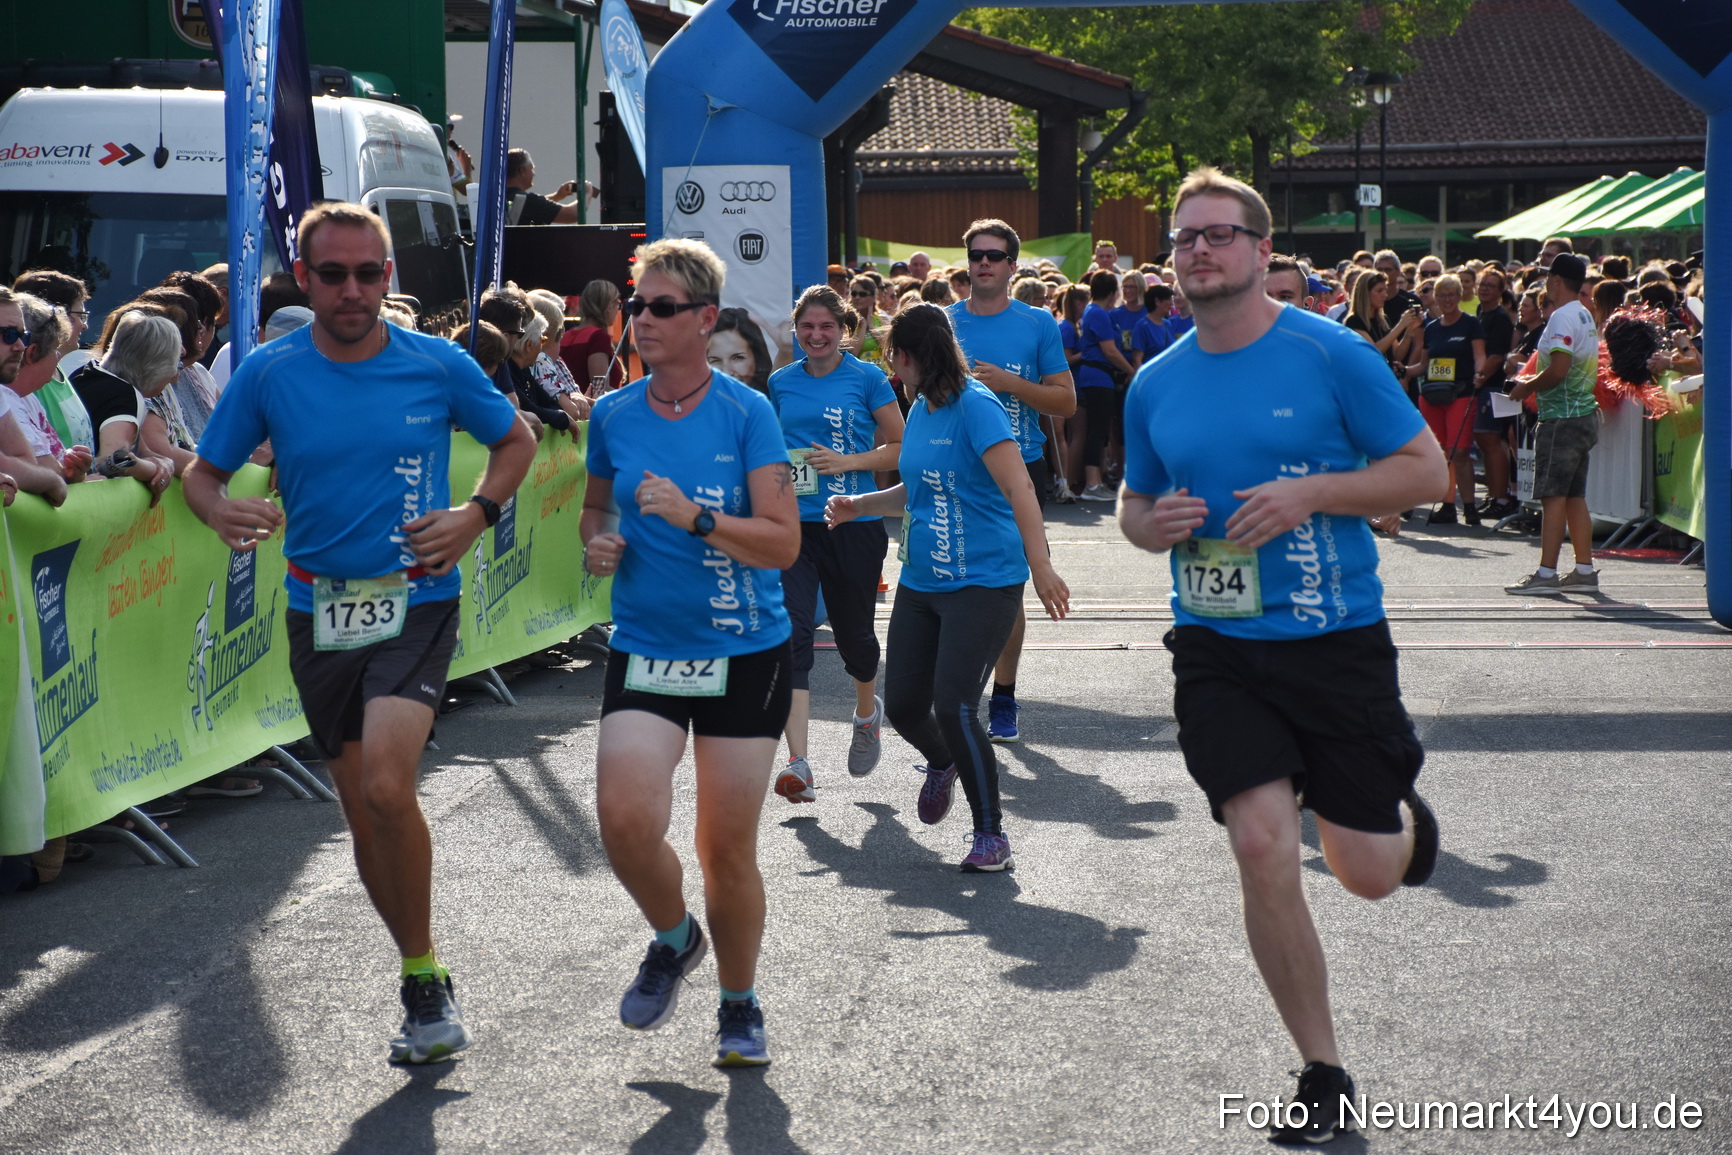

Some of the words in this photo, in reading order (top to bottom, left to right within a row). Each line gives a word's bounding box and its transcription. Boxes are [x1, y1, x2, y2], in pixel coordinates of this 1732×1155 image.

[775, 0, 888, 15] Fischer
[784, 17, 878, 28] AUTOMOBILE
[1362, 187, 1377, 203] WC
[722, 207, 746, 215] Audi
[742, 239, 762, 255] FIAT
[1430, 366, 1451, 375] 1386
[405, 414, 431, 425] Benni
[1273, 408, 1293, 417] Willi
[714, 453, 734, 463] Alex
[827, 430, 847, 494] been
[394, 453, 423, 487] di
[231, 551, 253, 573] Fischer
[486, 525, 534, 604] firmenlauf
[956, 537, 968, 580] Nathalies
[108, 564, 138, 621] laufen
[138, 537, 177, 608] länger!
[1184, 564, 1246, 595] 1734
[39, 583, 62, 612] Fischer
[1328, 565, 1348, 624] athalies
[325, 599, 395, 629] 1733
[210, 587, 278, 692] firmenlauf
[337, 628, 360, 637] Liebel
[643, 657, 714, 677] 1732
[656, 677, 679, 685] Liebel
[212, 680, 239, 721] neumarkt
[43, 735, 71, 783] neumarkt
